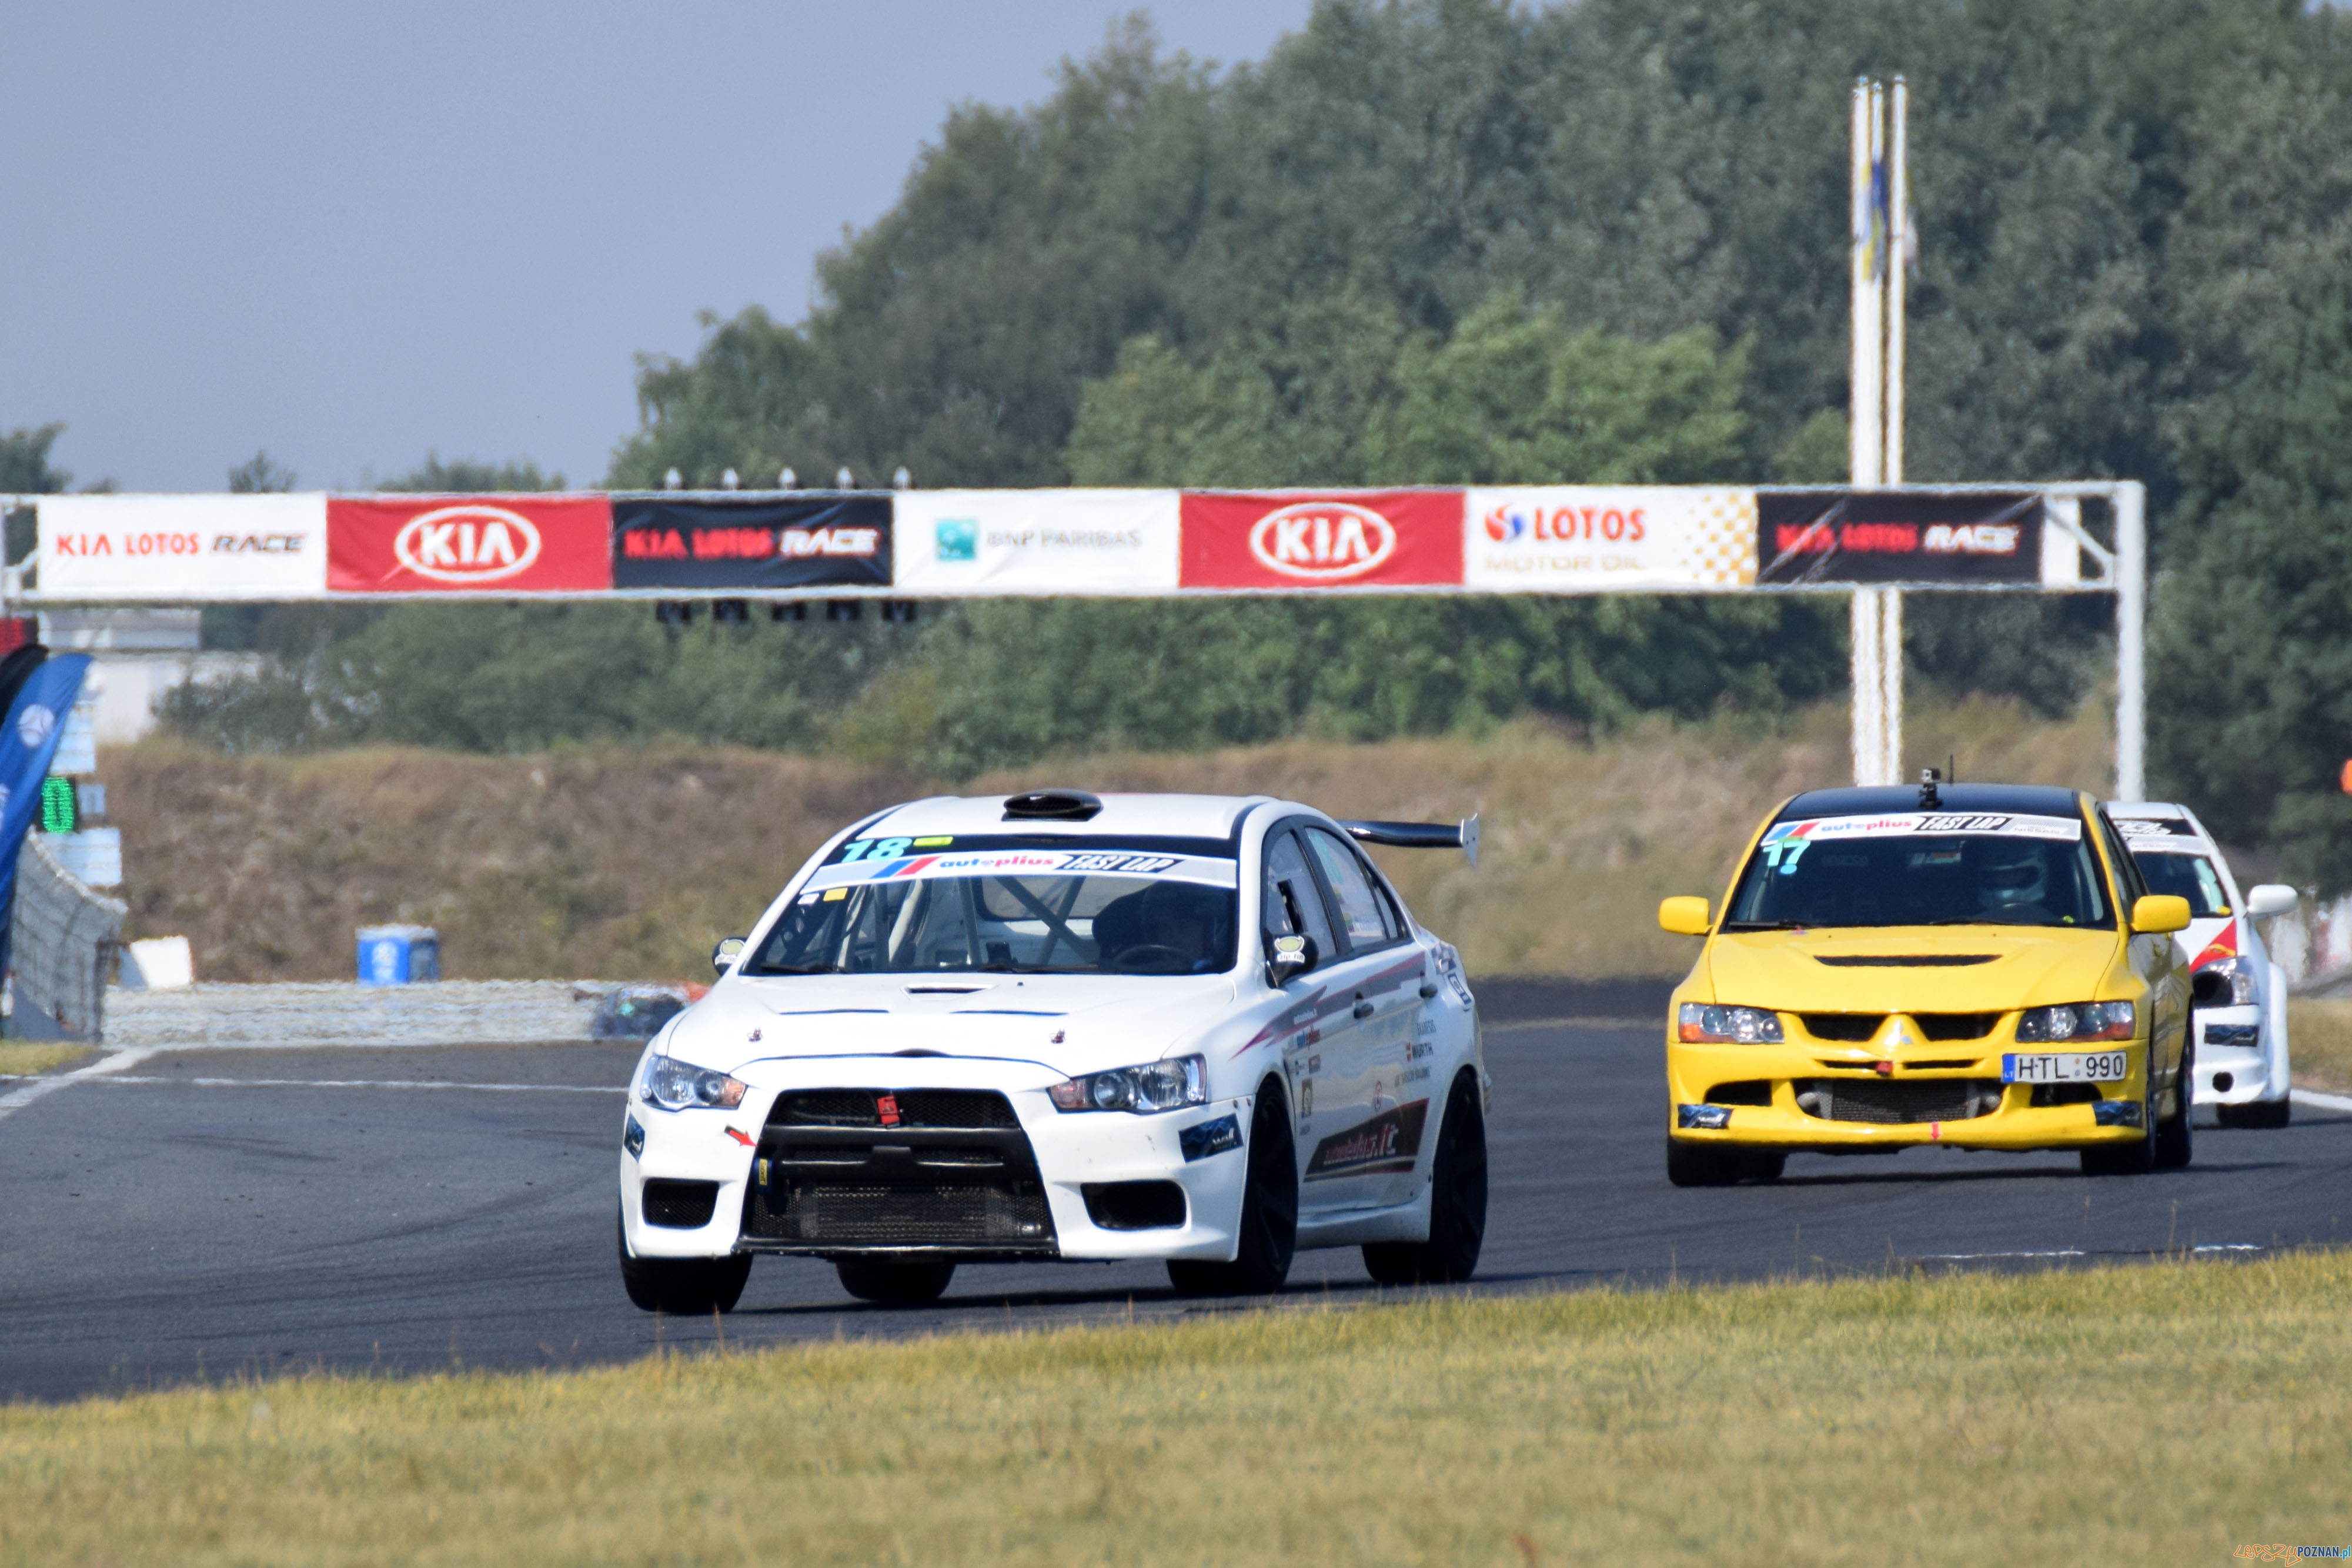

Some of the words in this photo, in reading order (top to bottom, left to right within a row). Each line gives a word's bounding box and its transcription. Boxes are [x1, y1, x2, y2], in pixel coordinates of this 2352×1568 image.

[1534, 506, 1645, 541] LOTOS
[56, 534, 112, 556] KIA
[125, 533, 199, 555] LOTOS
[209, 533, 306, 554] RACE
[420, 522, 516, 565] KIA
[780, 529, 878, 554] RACE
[987, 530, 1034, 547] BNP
[1040, 529, 1142, 548] PARIBAS
[1275, 518, 1371, 561] KIA
[1923, 524, 2019, 551] RACE
[1485, 555, 1591, 572] MOTOR
[1602, 555, 1645, 571] OIL
[1920, 816, 1970, 830] FAST
[1965, 816, 2007, 830] LAP
[841, 837, 912, 863] 18
[1763, 840, 1811, 866] 17
[939, 855, 1054, 868] autoplius
[1064, 854, 1125, 870] FAST
[1121, 857, 1174, 872] LAP
[2019, 1057, 2069, 1079] HTL
[2086, 1055, 2123, 1078] 990
